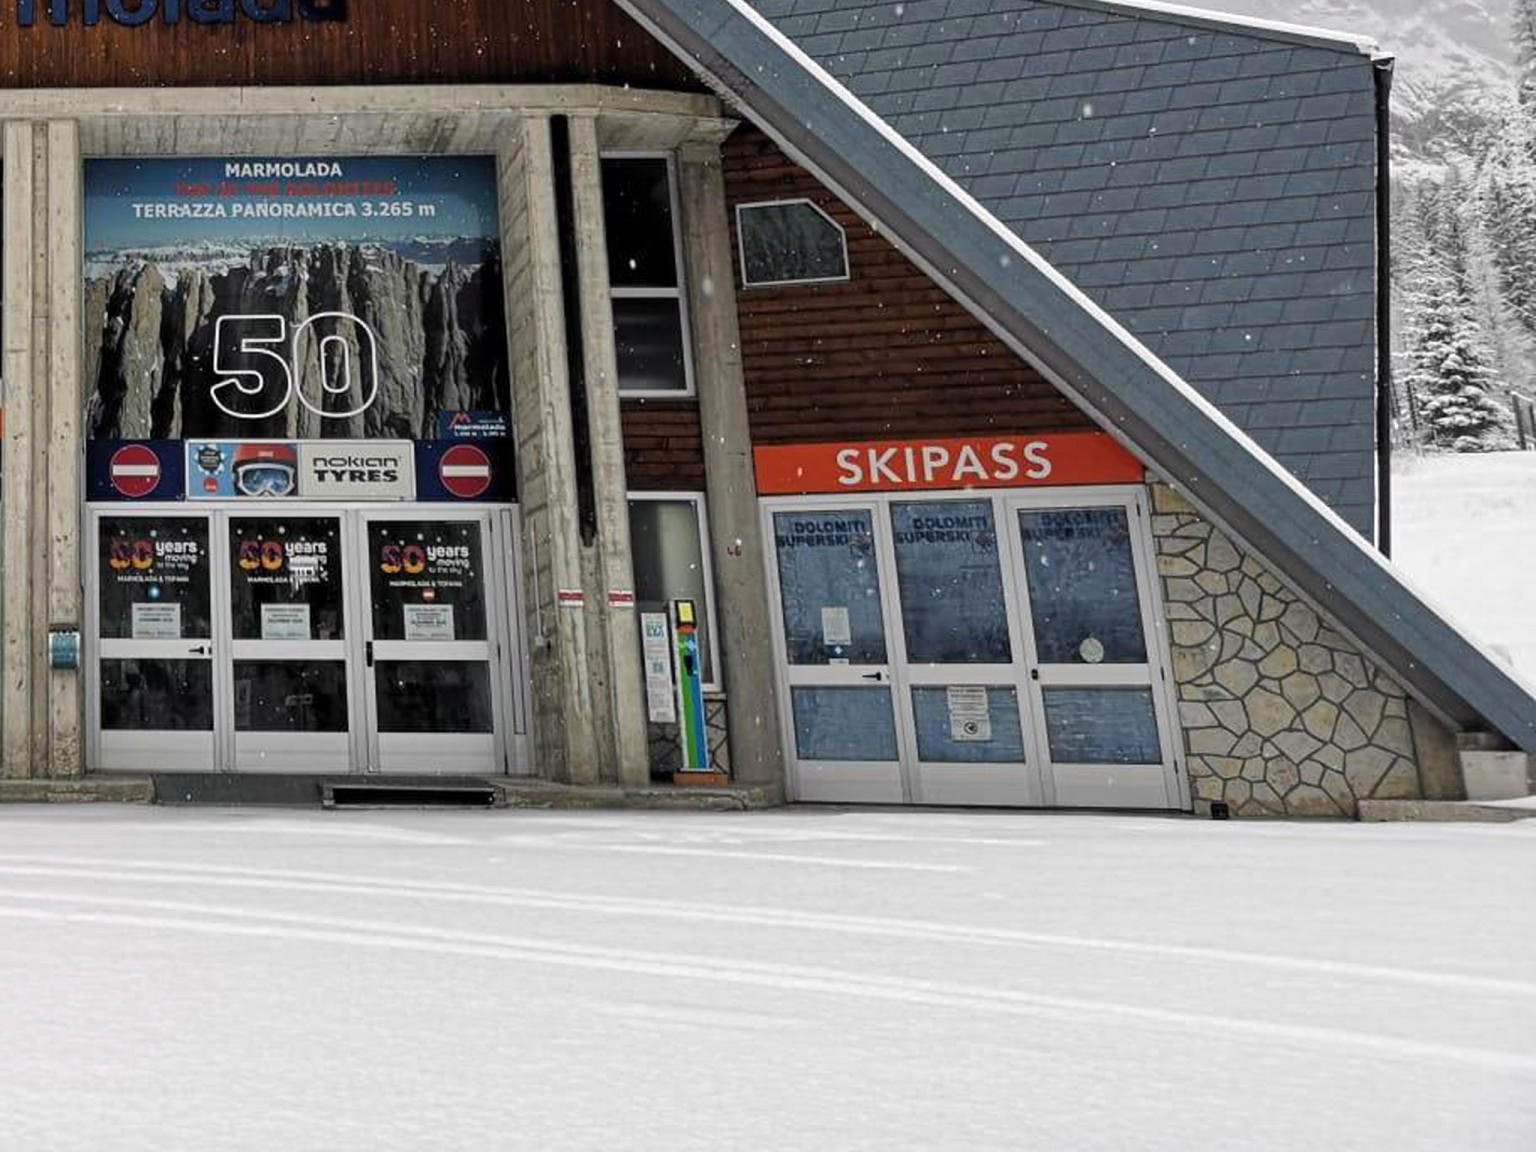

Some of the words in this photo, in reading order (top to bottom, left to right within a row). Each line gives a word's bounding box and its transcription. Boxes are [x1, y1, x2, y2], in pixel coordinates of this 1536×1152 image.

[225, 163, 343, 178] MARMOLADA
[133, 203, 226, 218] TERRAZZA
[231, 202, 356, 218] PANORAMICA
[361, 202, 413, 217] 3.265
[418, 204, 436, 216] m
[210, 311, 378, 419] 50
[313, 456, 398, 467] nokian
[836, 441, 1052, 485] SKIPASS
[313, 469, 398, 483] TYRES
[794, 520, 865, 533] DOLOMITI
[913, 517, 987, 530] DOLOMITI
[777, 534, 849, 547] SUPERSKI
[895, 531, 971, 543] SUPERSKI
[156, 541, 197, 556] years
[285, 542, 327, 557] years
[165, 554, 197, 564] moving
[381, 545, 425, 573] 50
[427, 546, 469, 561] years
[436, 558, 470, 568] moving
